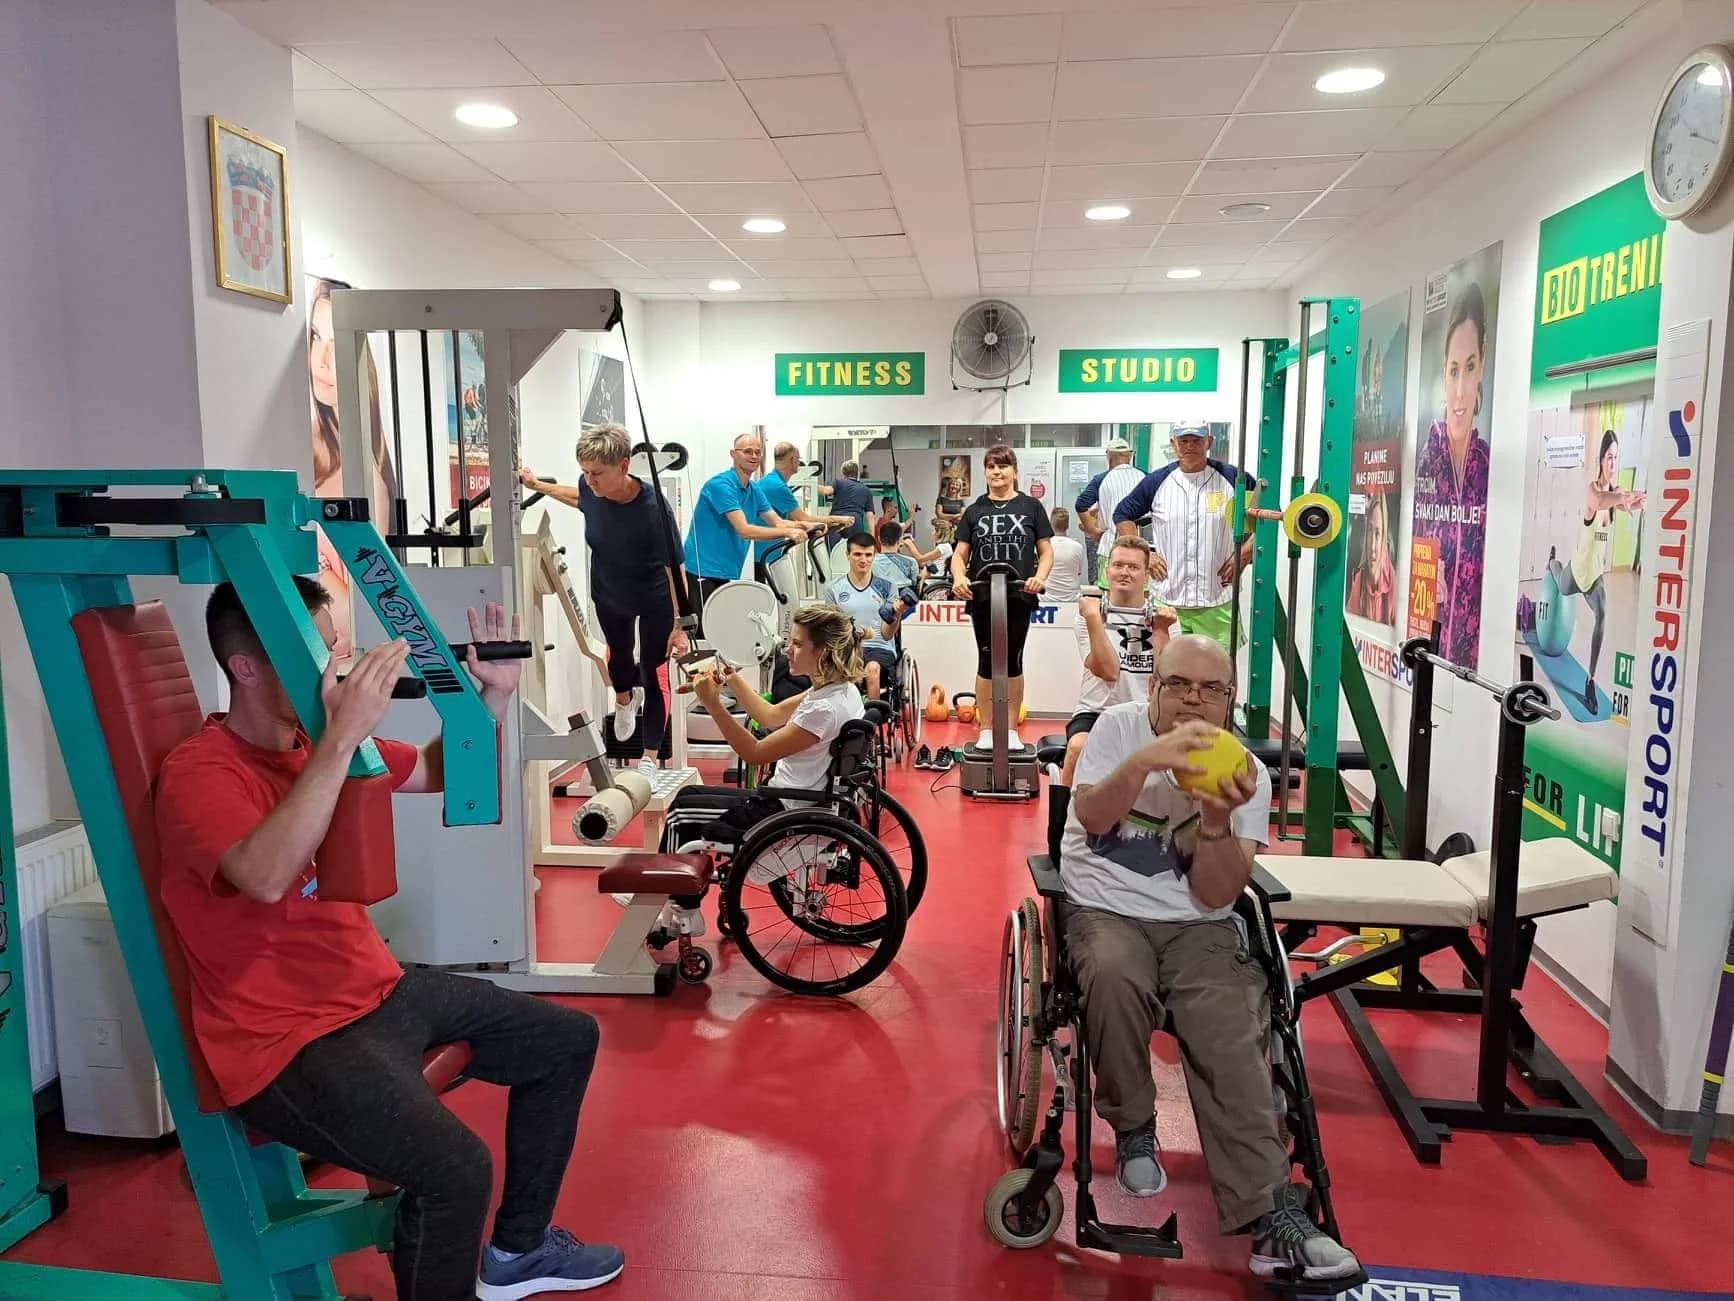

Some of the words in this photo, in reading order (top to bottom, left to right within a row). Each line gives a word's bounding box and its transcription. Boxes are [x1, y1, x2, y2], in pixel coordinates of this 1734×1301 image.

[1547, 266, 1580, 320] BIO
[788, 361, 912, 386] FITNESS
[1081, 357, 1195, 383] STUDIO
[1363, 449, 1388, 465] PLANINE
[1355, 472, 1367, 486] NAS
[976, 513, 1028, 538] SEX
[1415, 503, 1434, 520] SVAKI
[1434, 505, 1450, 521] DAN
[1451, 505, 1481, 525] BOLJE!
[980, 542, 1026, 562] CITY
[1411, 579, 1435, 620] -20%
[1538, 602, 1549, 621] FIT
[377, 595, 449, 669] GYM
[1362, 640, 1414, 687] INTERSPO
[1640, 467, 1692, 858] INTERSPORT
[1613, 691, 1628, 718] FOR
